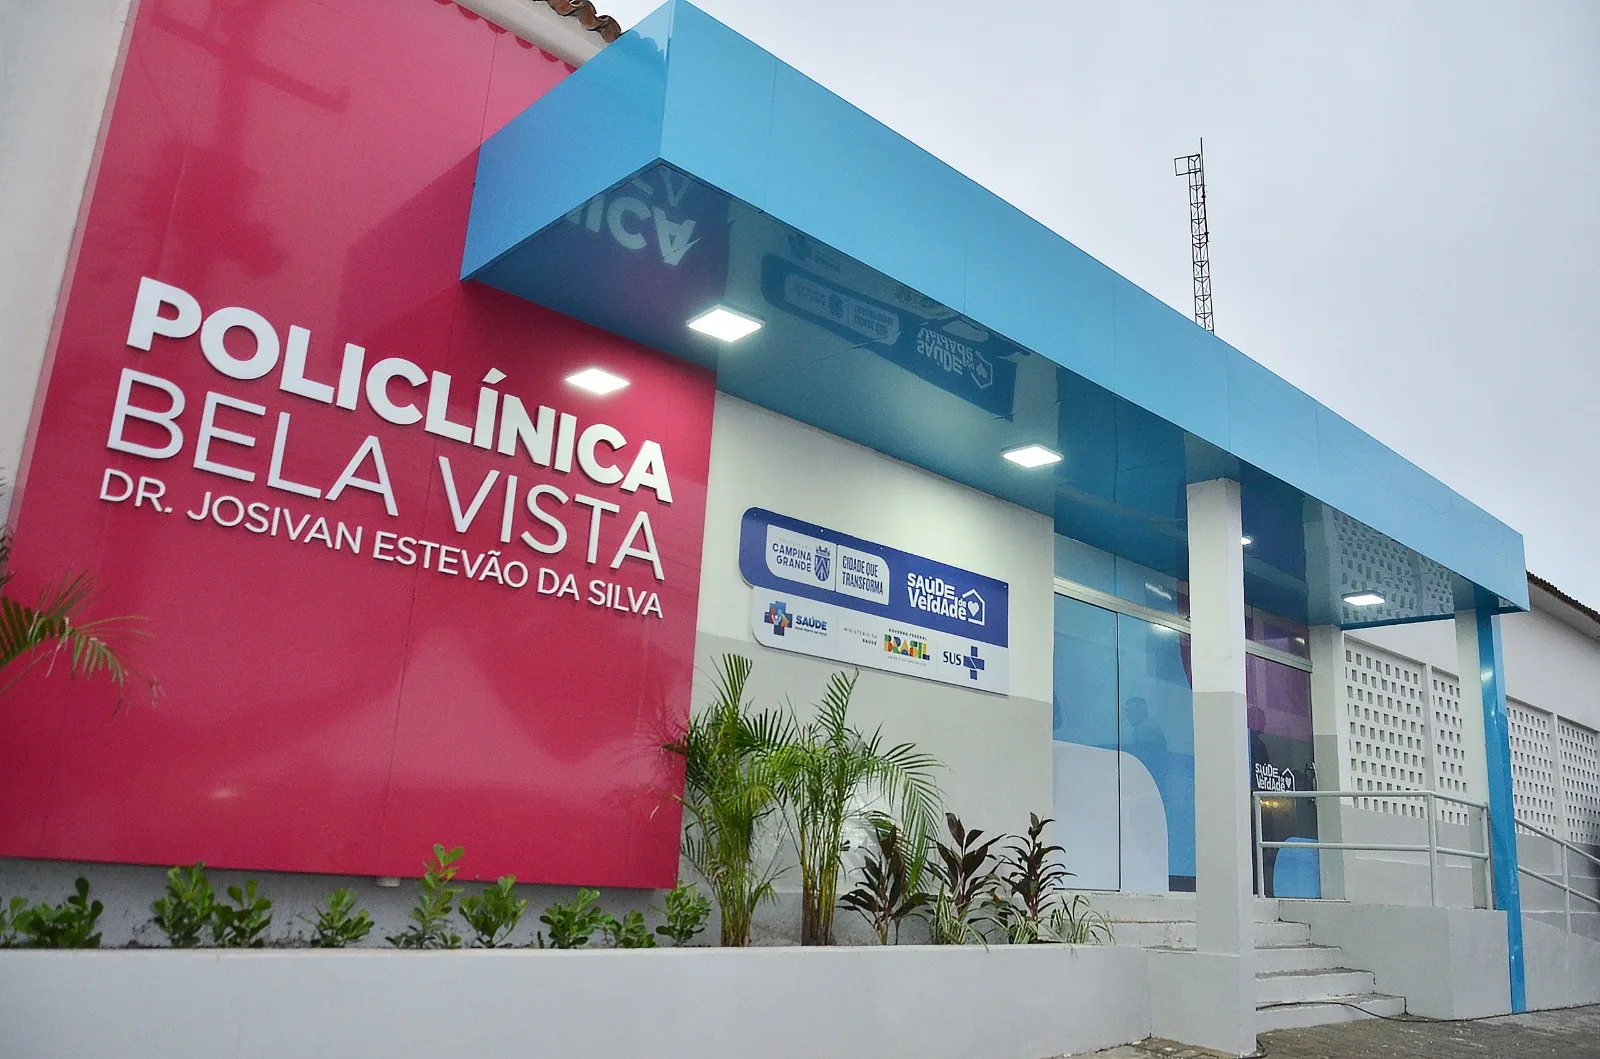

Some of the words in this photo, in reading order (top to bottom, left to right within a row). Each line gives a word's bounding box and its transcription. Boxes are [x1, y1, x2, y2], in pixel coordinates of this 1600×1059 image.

[126, 276, 673, 503] POLICLÍNICA
[106, 367, 398, 516] BELA
[438, 455, 665, 581] VISTA
[99, 468, 173, 513] DR.
[187, 491, 362, 555] JOSIVAN
[372, 532, 528, 589] ESTEVÃO
[537, 568, 580, 601] DA
[587, 580, 664, 619] SILVA
[772, 543, 812, 562] CAMPINA
[776, 555, 812, 573] GRANDE
[842, 555, 865, 574] CIDADE
[866, 562, 878, 578] QUE
[842, 571, 883, 595] TRANSFORMA
[795, 614, 827, 631] SAÚDE
[884, 634, 930, 661] BRASIL
[943, 651, 961, 666] SUS
